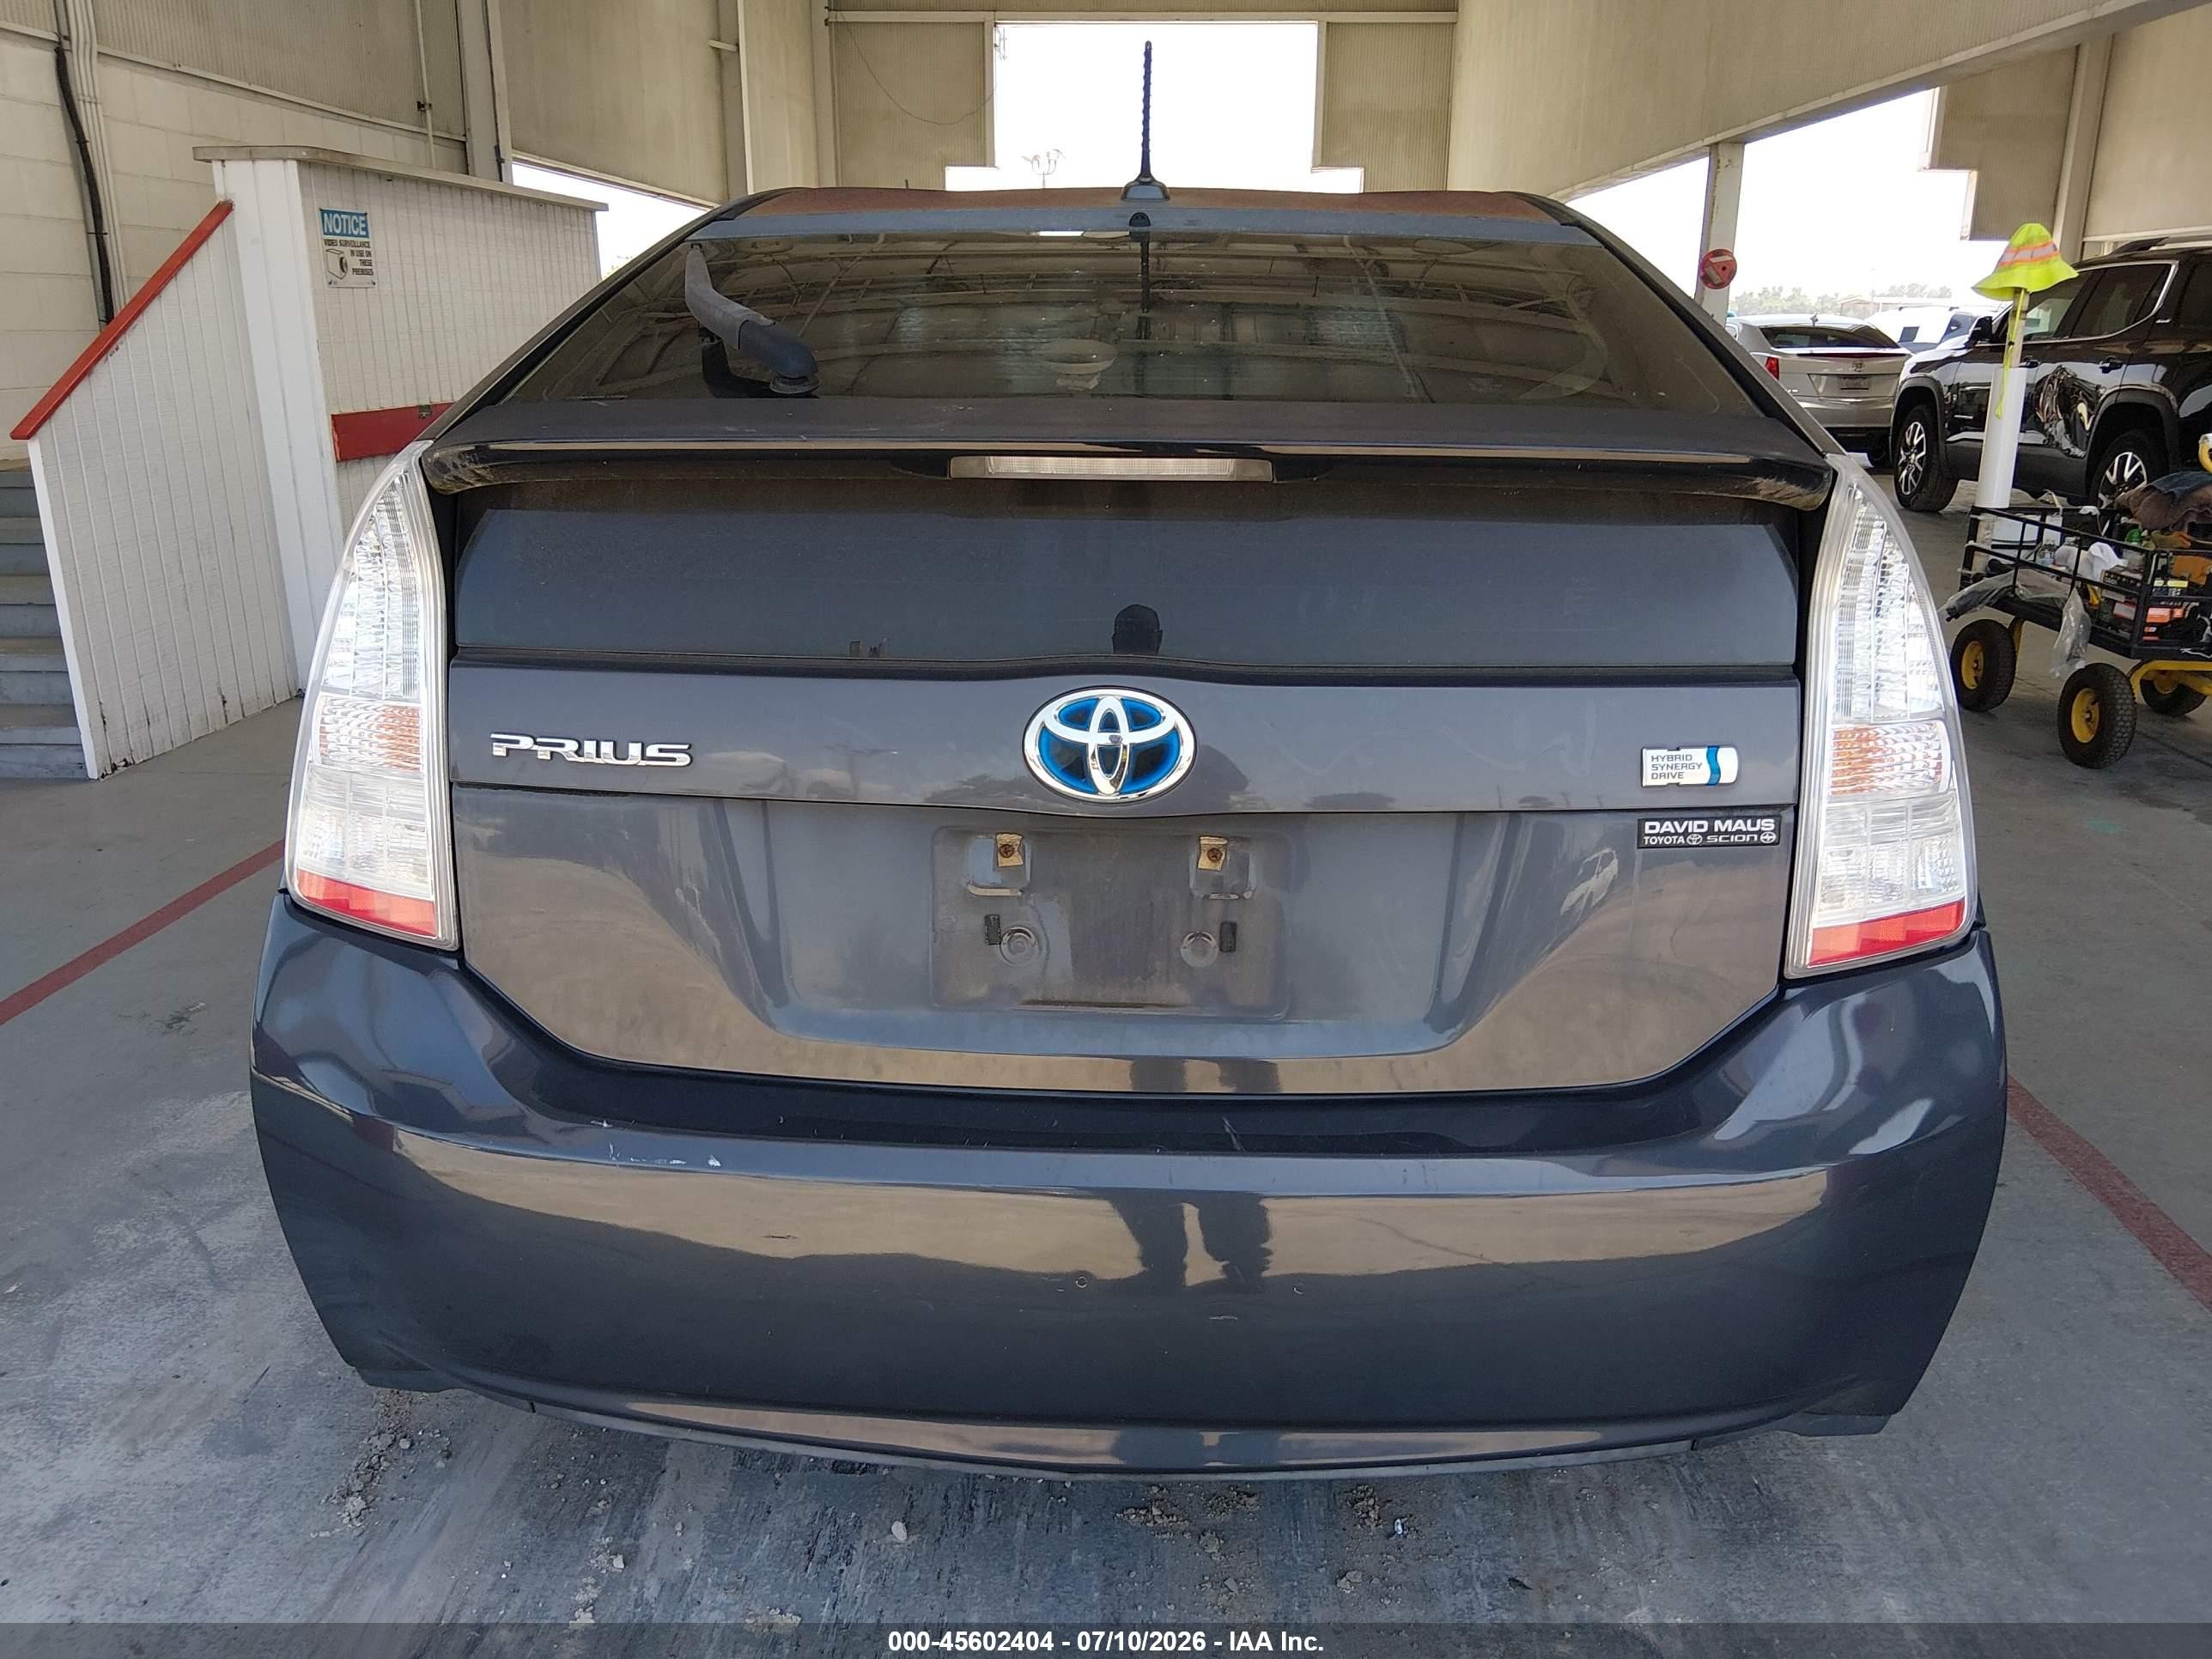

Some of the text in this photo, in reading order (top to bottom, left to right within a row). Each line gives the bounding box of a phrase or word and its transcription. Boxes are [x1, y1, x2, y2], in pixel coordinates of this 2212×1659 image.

[324, 213, 366, 235] NOTICE
[490, 732, 693, 768] PRIUS
[1650, 754, 1692, 763] HYBRID
[1650, 763, 1703, 771] SYNERGY
[1644, 818, 1775, 834] DAVID MAUS
[1644, 836, 1685, 845] TOYOTA
